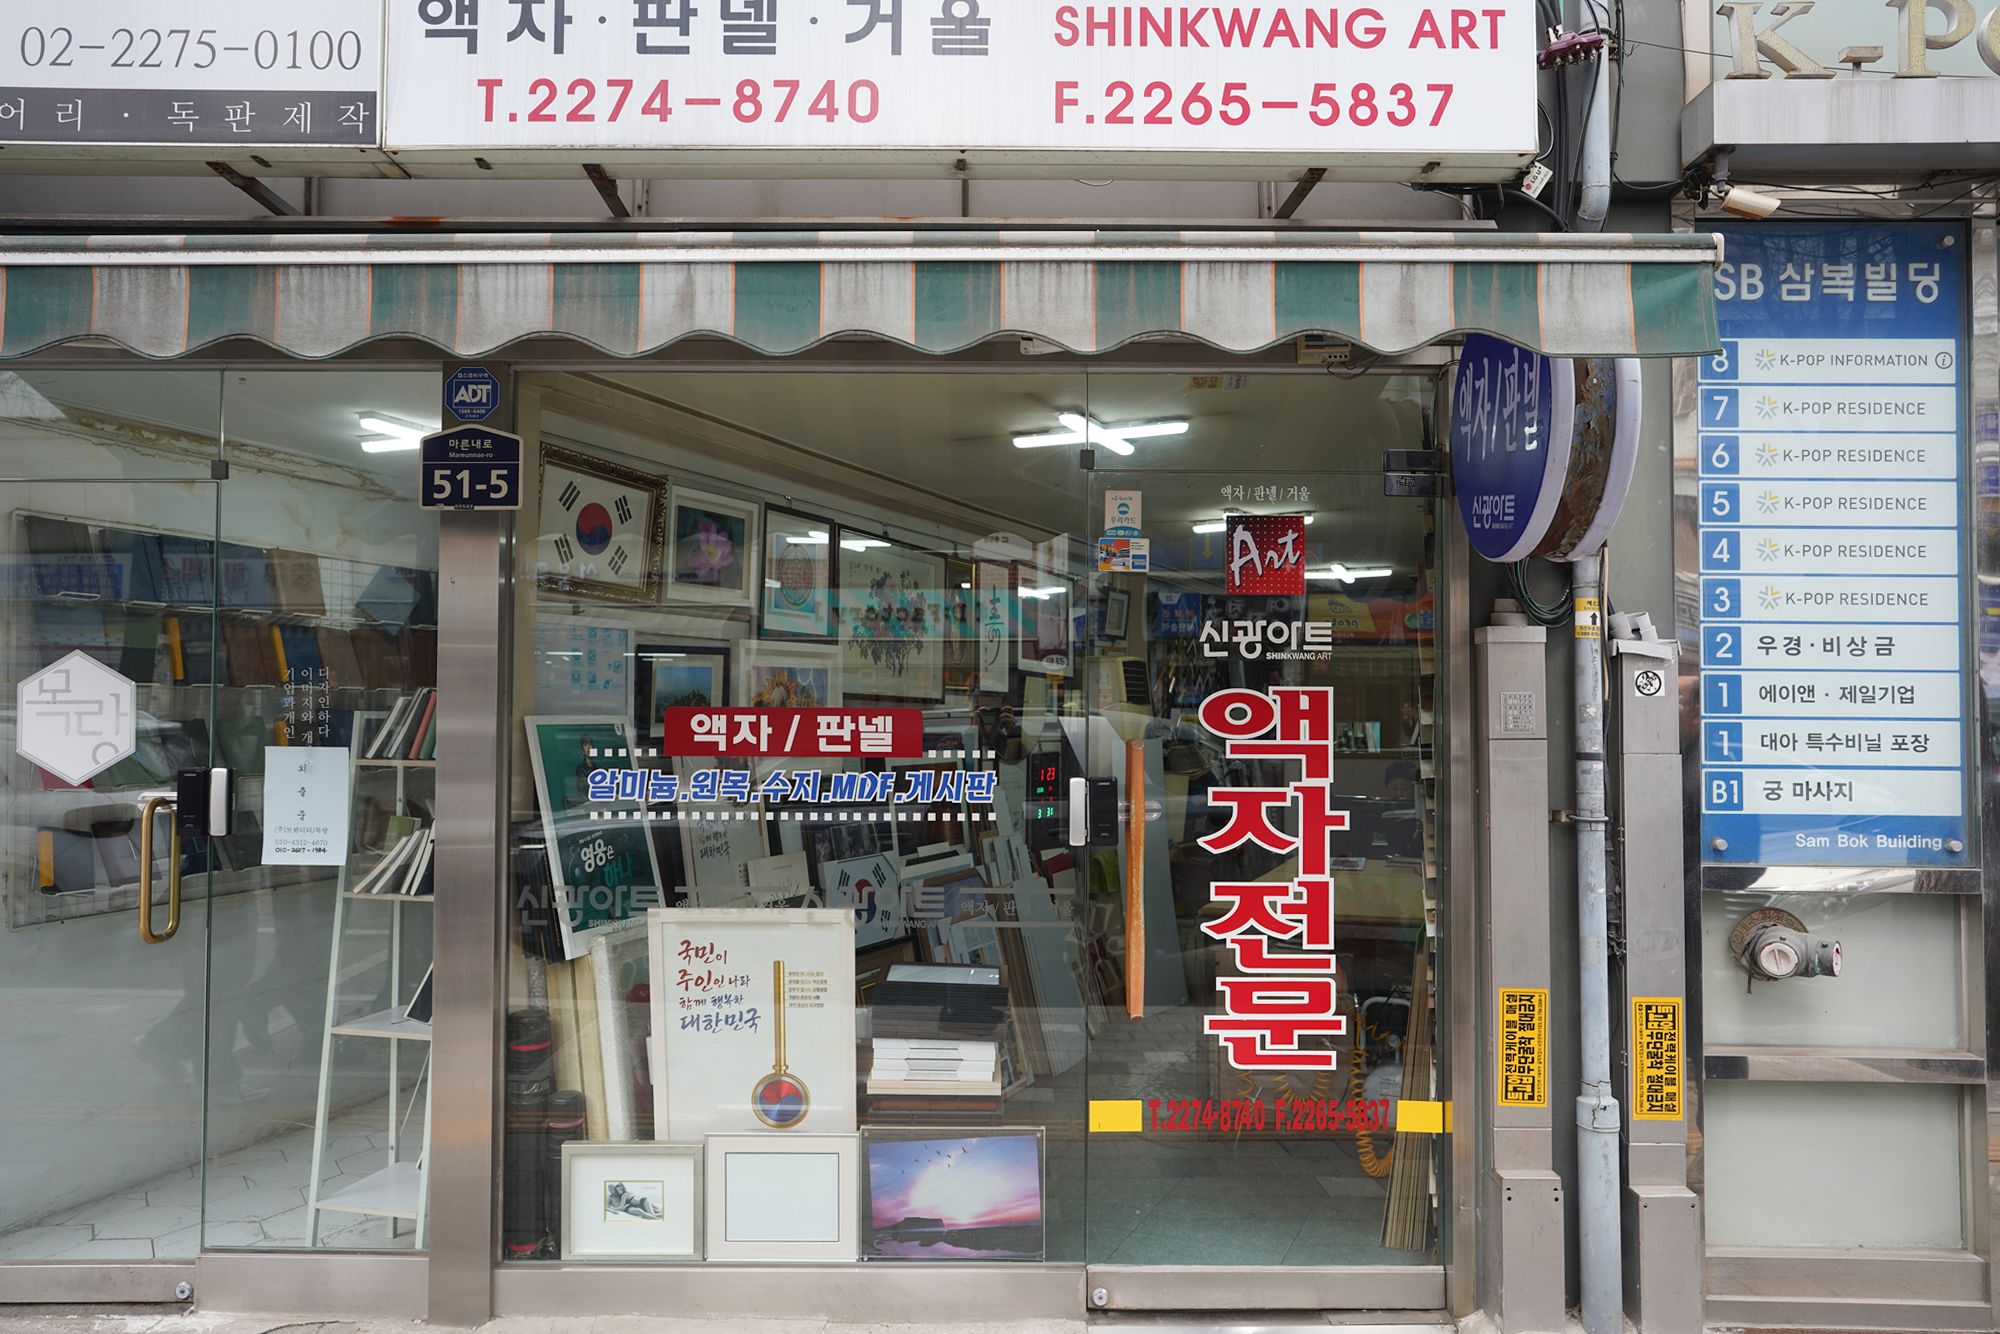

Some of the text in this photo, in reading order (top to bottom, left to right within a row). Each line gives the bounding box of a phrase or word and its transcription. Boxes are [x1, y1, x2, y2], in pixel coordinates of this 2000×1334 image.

[1053, 5, 1506, 50] SHINKWANG ART
[19, 26, 363, 70] 02-2275-0100
[477, 78, 880, 123] T.2274-8740
[1053, 80, 1455, 127] F.2265-5837
[1714, 261, 1941, 304] SB 삼복빌딩
[1711, 348, 1928, 373] 8 K-POP INFORMATION
[454, 384, 491, 403] ADT
[1712, 396, 1926, 421] 7 K-POP RESIDENCE
[448, 439, 493, 451] 마른내로
[1711, 443, 1926, 469] 6 K-POP RESIDENCE
[432, 469, 509, 499] 51-5
[1221, 485, 1244, 501] 액자
[1253, 485, 1277, 501] 판넬
[1286, 486, 1311, 501] 거울
[1472, 494, 1515, 529] 신광아트
[1711, 491, 1927, 517] 5 K-POP RESIDENCE
[1231, 524, 1300, 587] Art
[1712, 538, 1927, 563] 4 K-POP RESIDENCE
[1713, 587, 1929, 612] 3 K-POP RESIDENCE
[1199, 620, 1332, 660] 신광아트
[1715, 632, 1733, 658] 2
[1265, 652, 1332, 660] SHINKWANG ART
[318, 667, 331, 739] 디자인하다
[1717, 682, 1729, 708] 1
[1758, 684, 1816, 704] 에이앤
[1838, 685, 1916, 705] 제일기업
[689, 713, 773, 753] 액자
[816, 713, 893, 753] 판넬
[1718, 730, 1930, 756] 1 대아 특수비닐 포장
[1712, 779, 1854, 804] B1 궁 마사지
[1795, 833, 1943, 850] Sam Bok Building
[1197, 686, 1350, 1070] 액자전문
[678, 939, 728, 965] 국민이
[728, 975, 750, 989] 나라
[679, 996, 707, 1010] 함께
[680, 1007, 762, 1034] 대한민국
[1505, 993, 1518, 1074] 전력케이블 매설
[1518, 994, 1536, 1075] 무단굴착 절대금지
[1646, 1031, 1663, 1113] 무단굴착 절대금지
[1664, 1031, 1676, 1113] 전력케이블 매설
[1148, 1098, 1390, 1131] T.2274-8740 F.2265-5837
